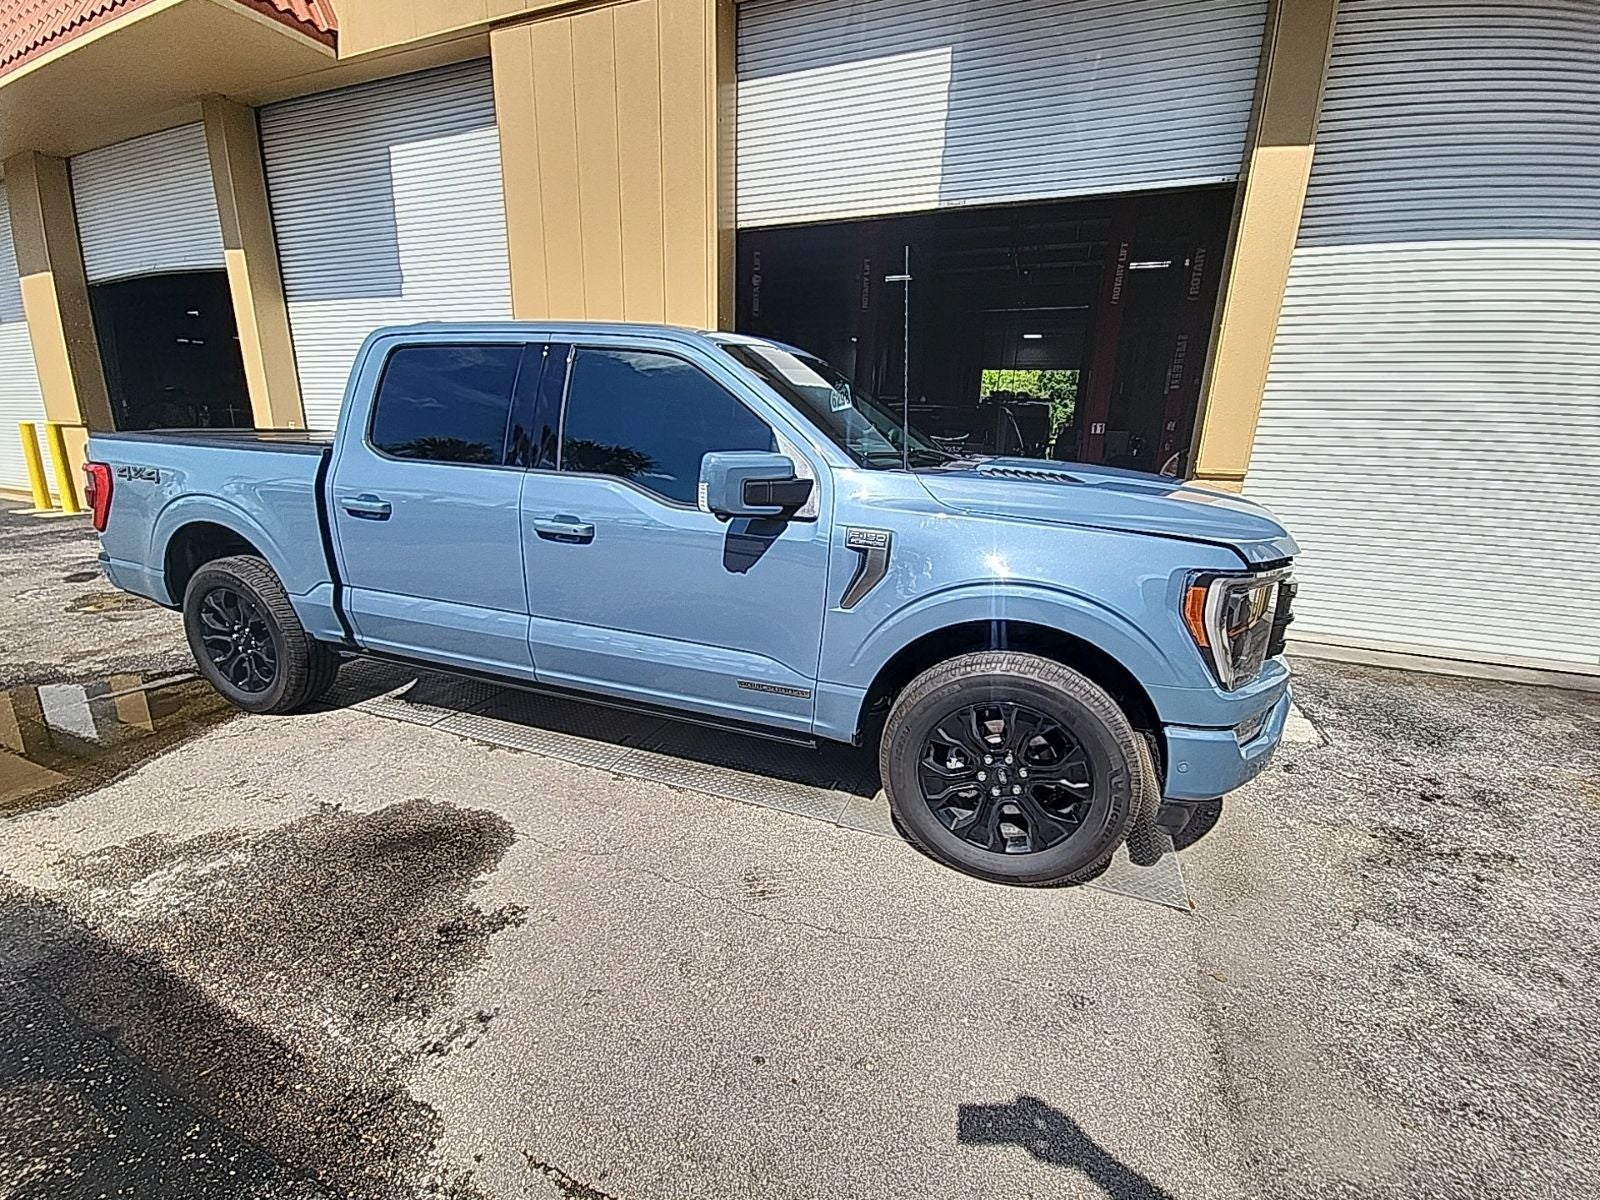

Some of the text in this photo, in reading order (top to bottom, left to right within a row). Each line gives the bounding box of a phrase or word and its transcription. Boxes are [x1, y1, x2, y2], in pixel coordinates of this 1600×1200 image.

[1111, 242, 1128, 300] ROTARY LIFT
[1189, 247, 1206, 295] ROTARY
[850, 531, 886, 542] F-150
